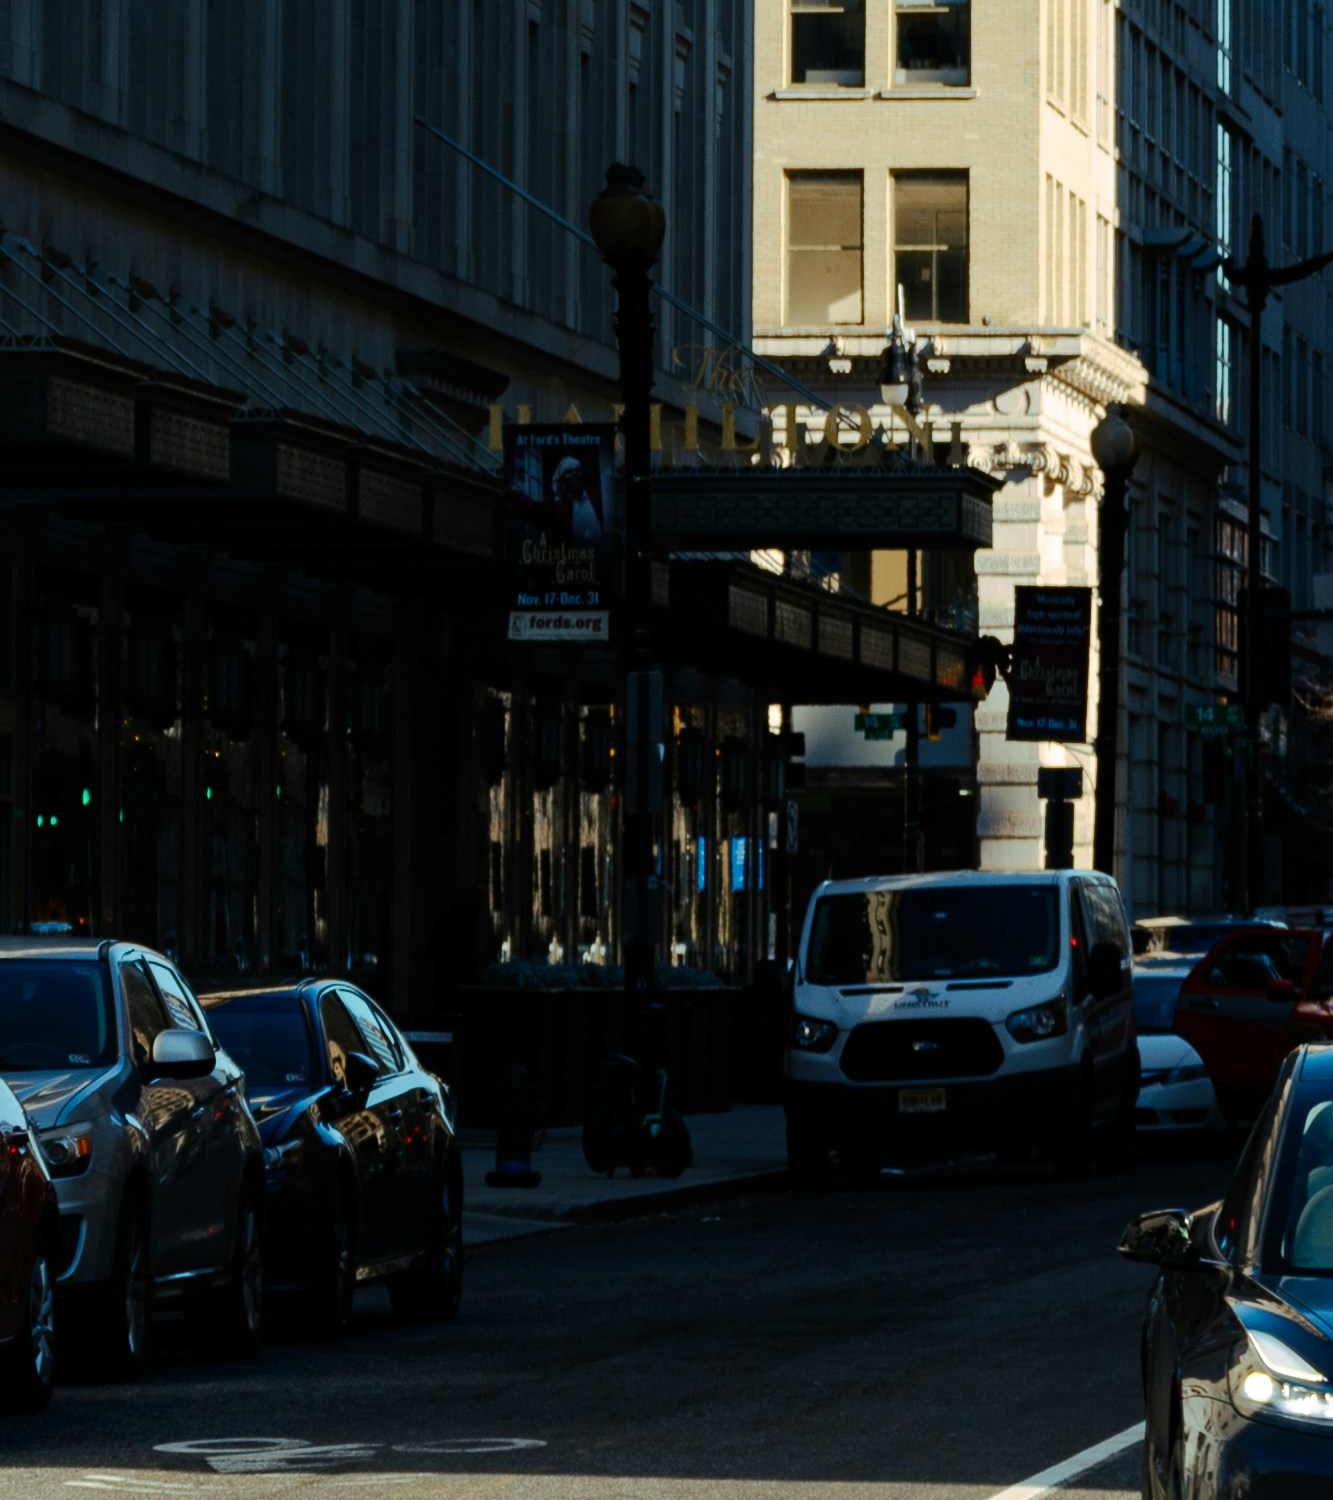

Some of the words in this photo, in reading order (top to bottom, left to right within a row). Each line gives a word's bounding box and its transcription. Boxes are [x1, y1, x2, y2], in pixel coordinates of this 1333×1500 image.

[516, 433, 527, 446] At
[530, 433, 559, 446] Ford's
[562, 432, 601, 446] Theatre
[521, 538, 596, 564] Christmas
[555, 558, 595, 584] Carol
[517, 592, 542, 606] Nov.
[529, 615, 602, 632] fords.org
[1197, 706, 1214, 722] 14
